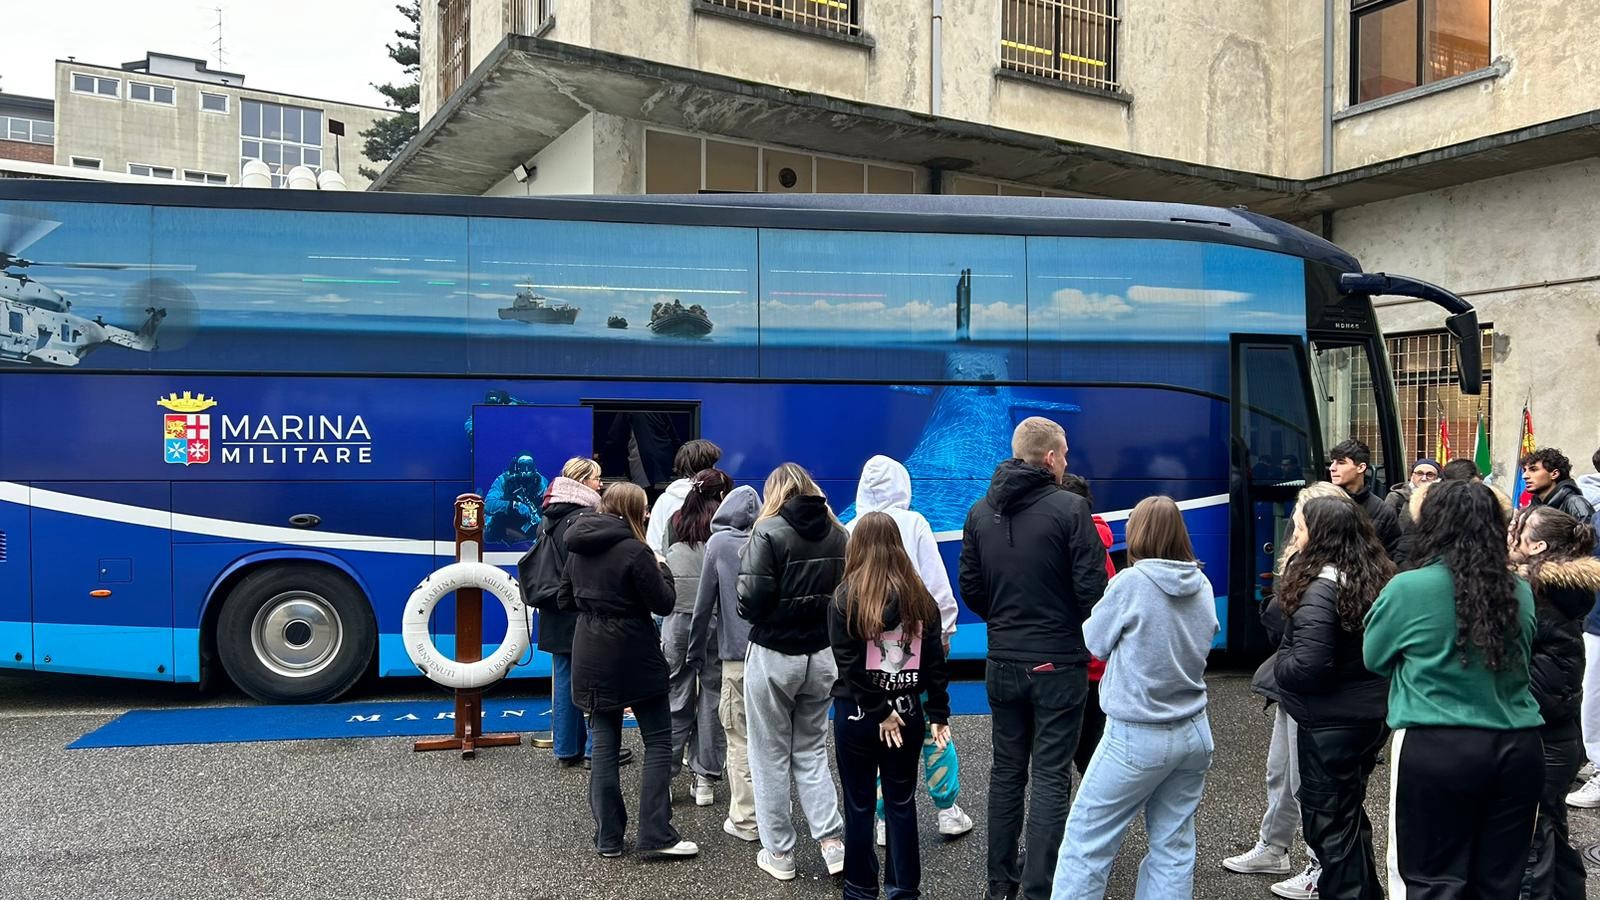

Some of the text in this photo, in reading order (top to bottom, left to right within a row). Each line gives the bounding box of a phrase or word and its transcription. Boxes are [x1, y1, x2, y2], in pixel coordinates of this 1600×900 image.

[221, 415, 371, 440] MARINA
[221, 447, 372, 463] MILITARE
[421, 579, 456, 607] MARINA
[416, 642, 455, 677] BENVENUTI
[493, 643, 518, 671] BORDO
